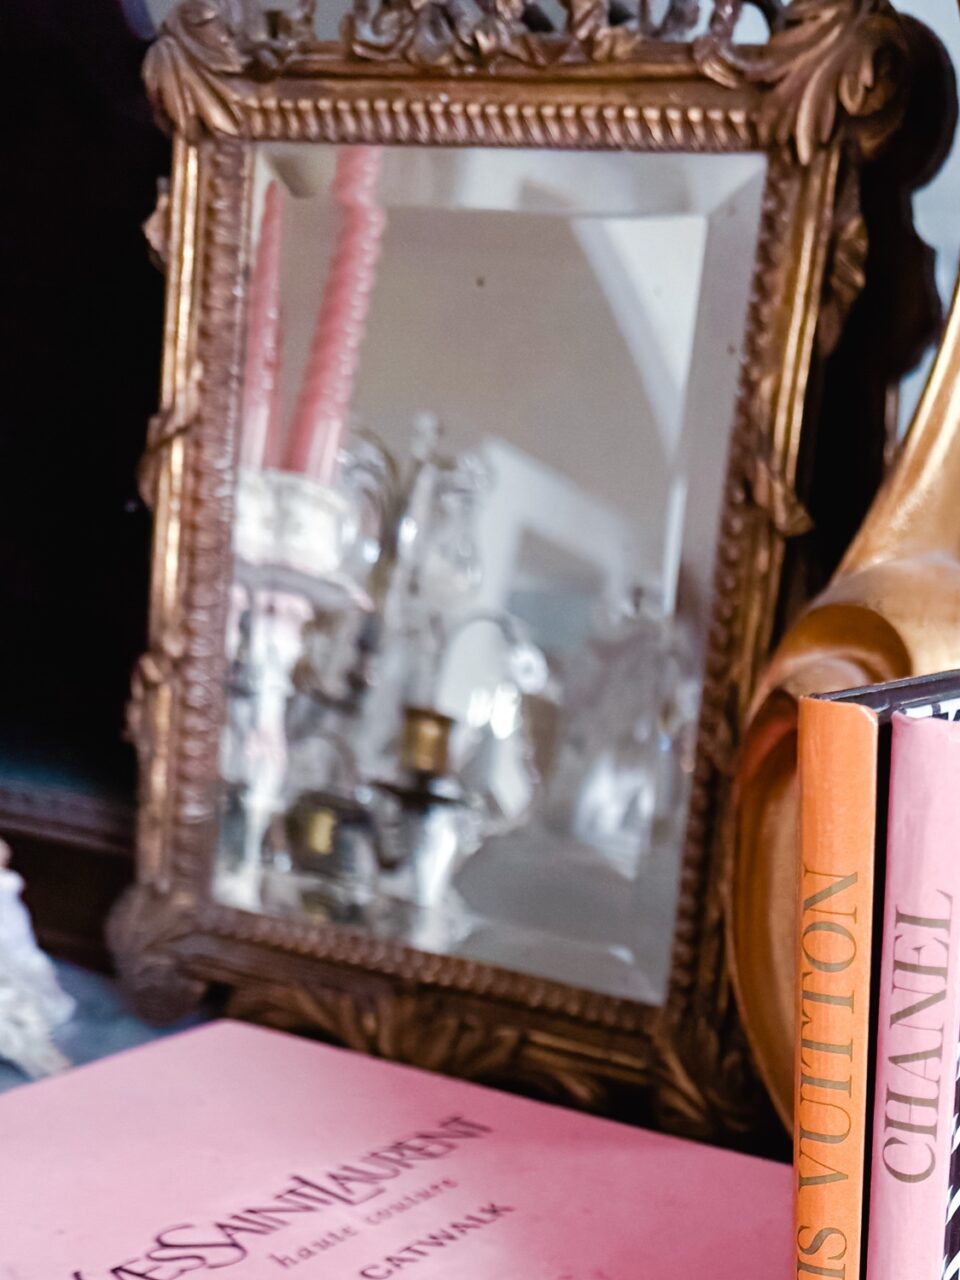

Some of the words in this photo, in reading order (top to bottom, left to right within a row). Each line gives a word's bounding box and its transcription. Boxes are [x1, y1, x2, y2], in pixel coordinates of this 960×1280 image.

[798, 865, 858, 1191] VUITTON
[882, 888, 954, 1184] CHANEL
[268, 1225, 357, 1269] haute
[358, 1201, 516, 1280] CATWALK
